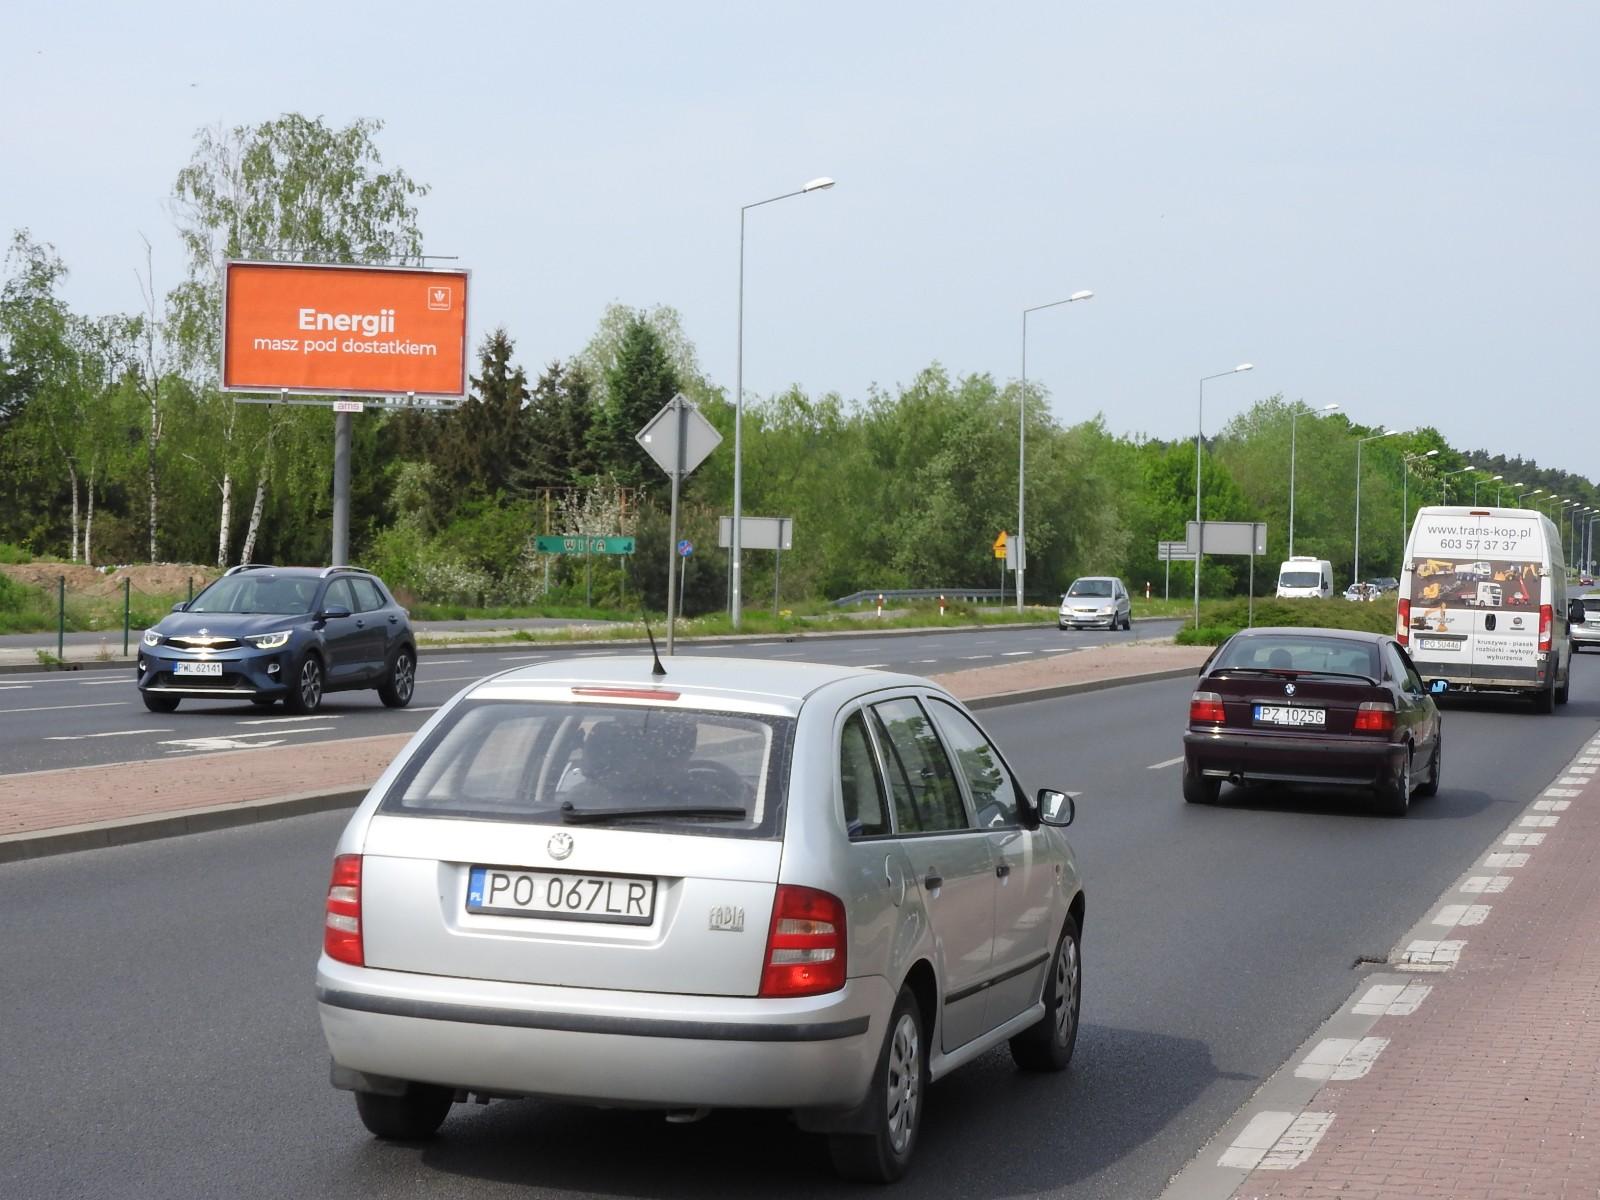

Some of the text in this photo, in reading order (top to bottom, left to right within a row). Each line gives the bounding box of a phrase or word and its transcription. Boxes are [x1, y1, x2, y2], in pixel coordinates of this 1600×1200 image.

[298, 308, 396, 337] Energii
[254, 337, 437, 356] masz pod dostatkiem
[1427, 525, 1532, 539] www.trans-kop.pl
[1440, 538, 1517, 551] 603 57 37 37
[196, 663, 220, 673] 62141
[1262, 707, 1324, 723] PZ 1025G
[488, 873, 647, 915] PO 067LR
[709, 904, 745, 926] FABIA
